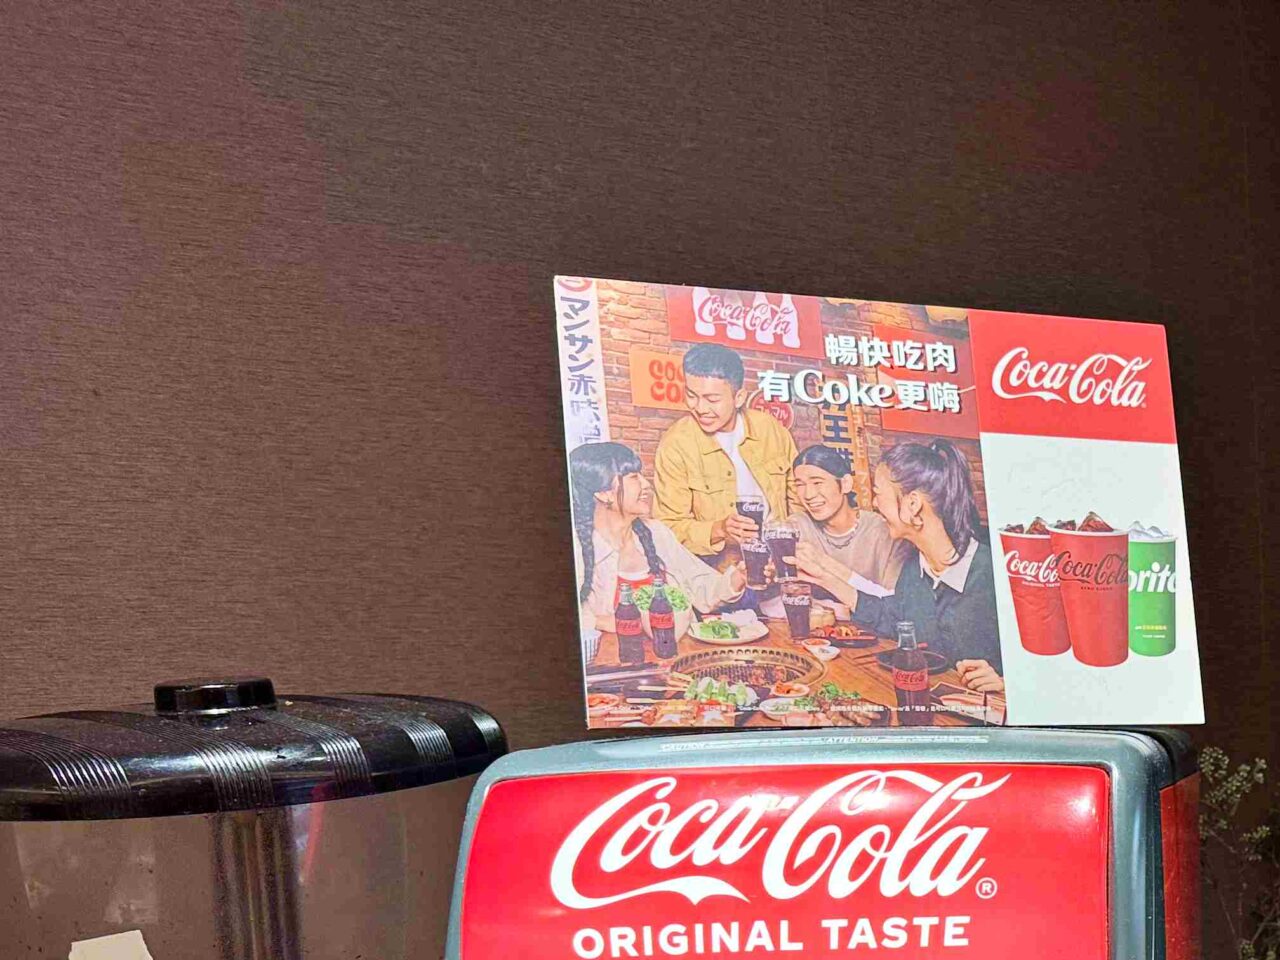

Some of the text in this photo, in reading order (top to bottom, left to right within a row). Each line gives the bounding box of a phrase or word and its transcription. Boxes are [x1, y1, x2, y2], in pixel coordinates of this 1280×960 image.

[824, 333, 957, 373] 暢快吃肉
[992, 347, 1153, 407] Coca-Cola
[550, 769, 1012, 909] Coca-Cola
[572, 915, 971, 959] ORIGINAL TASTE
